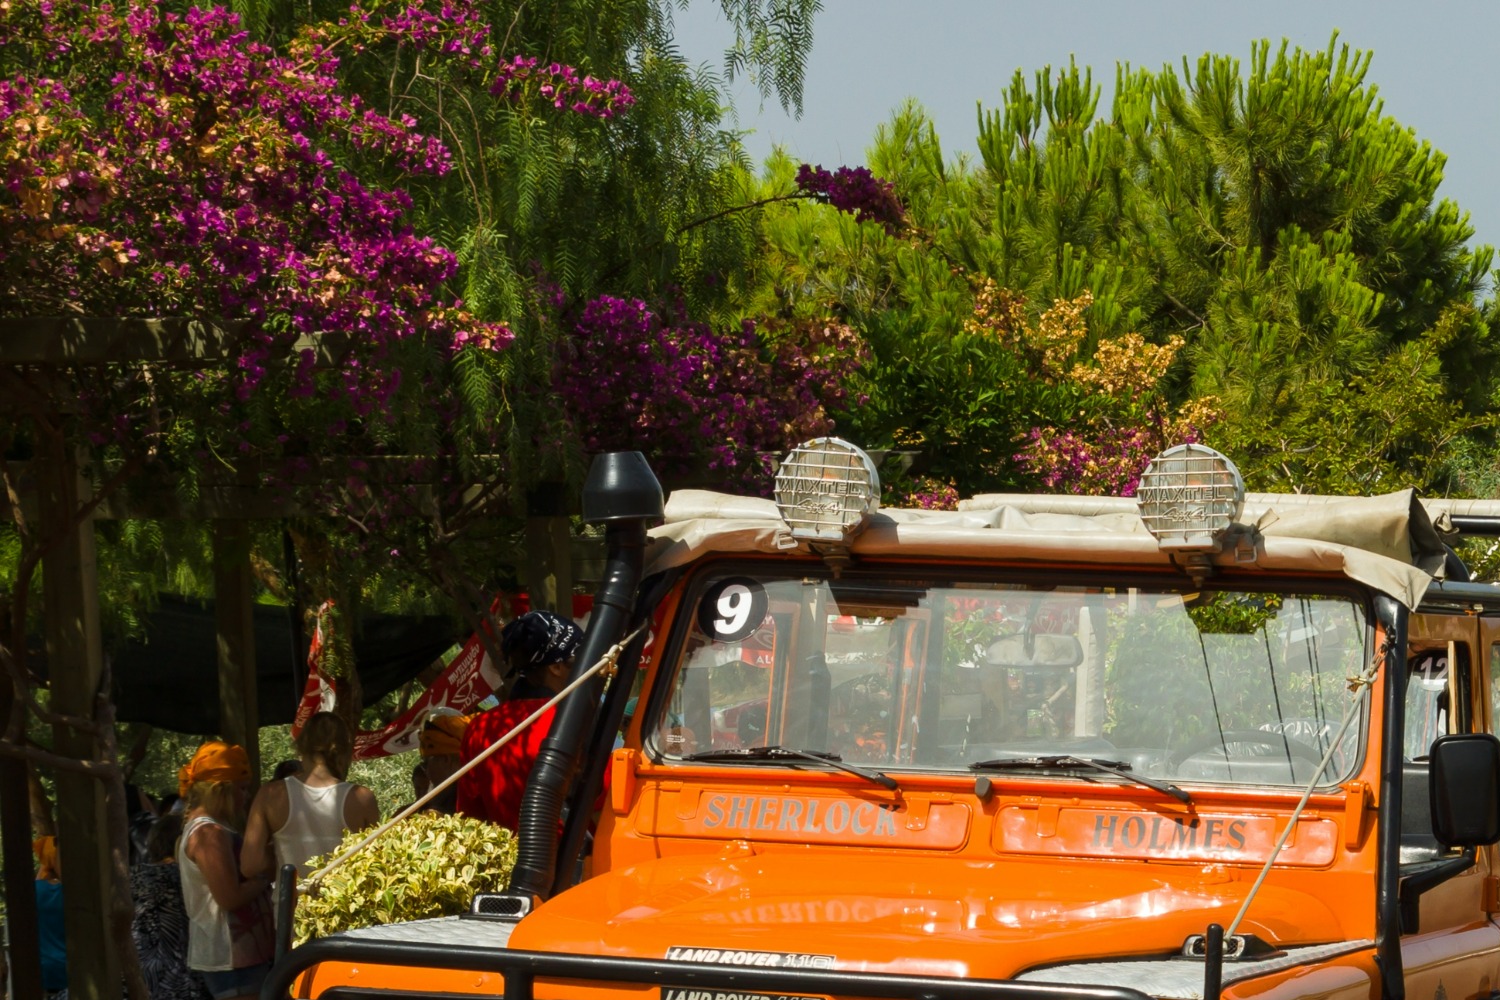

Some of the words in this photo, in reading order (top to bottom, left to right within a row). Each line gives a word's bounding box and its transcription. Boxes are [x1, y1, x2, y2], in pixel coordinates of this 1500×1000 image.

[780, 478, 862, 497] MAXTEL
[1143, 486, 1227, 504] MAXTEL
[797, 498, 843, 516] 4x4
[1162, 505, 1206, 522] 4x4
[713, 584, 753, 635] 9
[1420, 656, 1449, 686] 12
[702, 794, 899, 838] SHERLOCK
[1094, 814, 1247, 852] HOLMES
[669, 948, 720, 963] LAND
[719, 951, 781, 967] ROVER
[783, 953, 833, 969] 110
